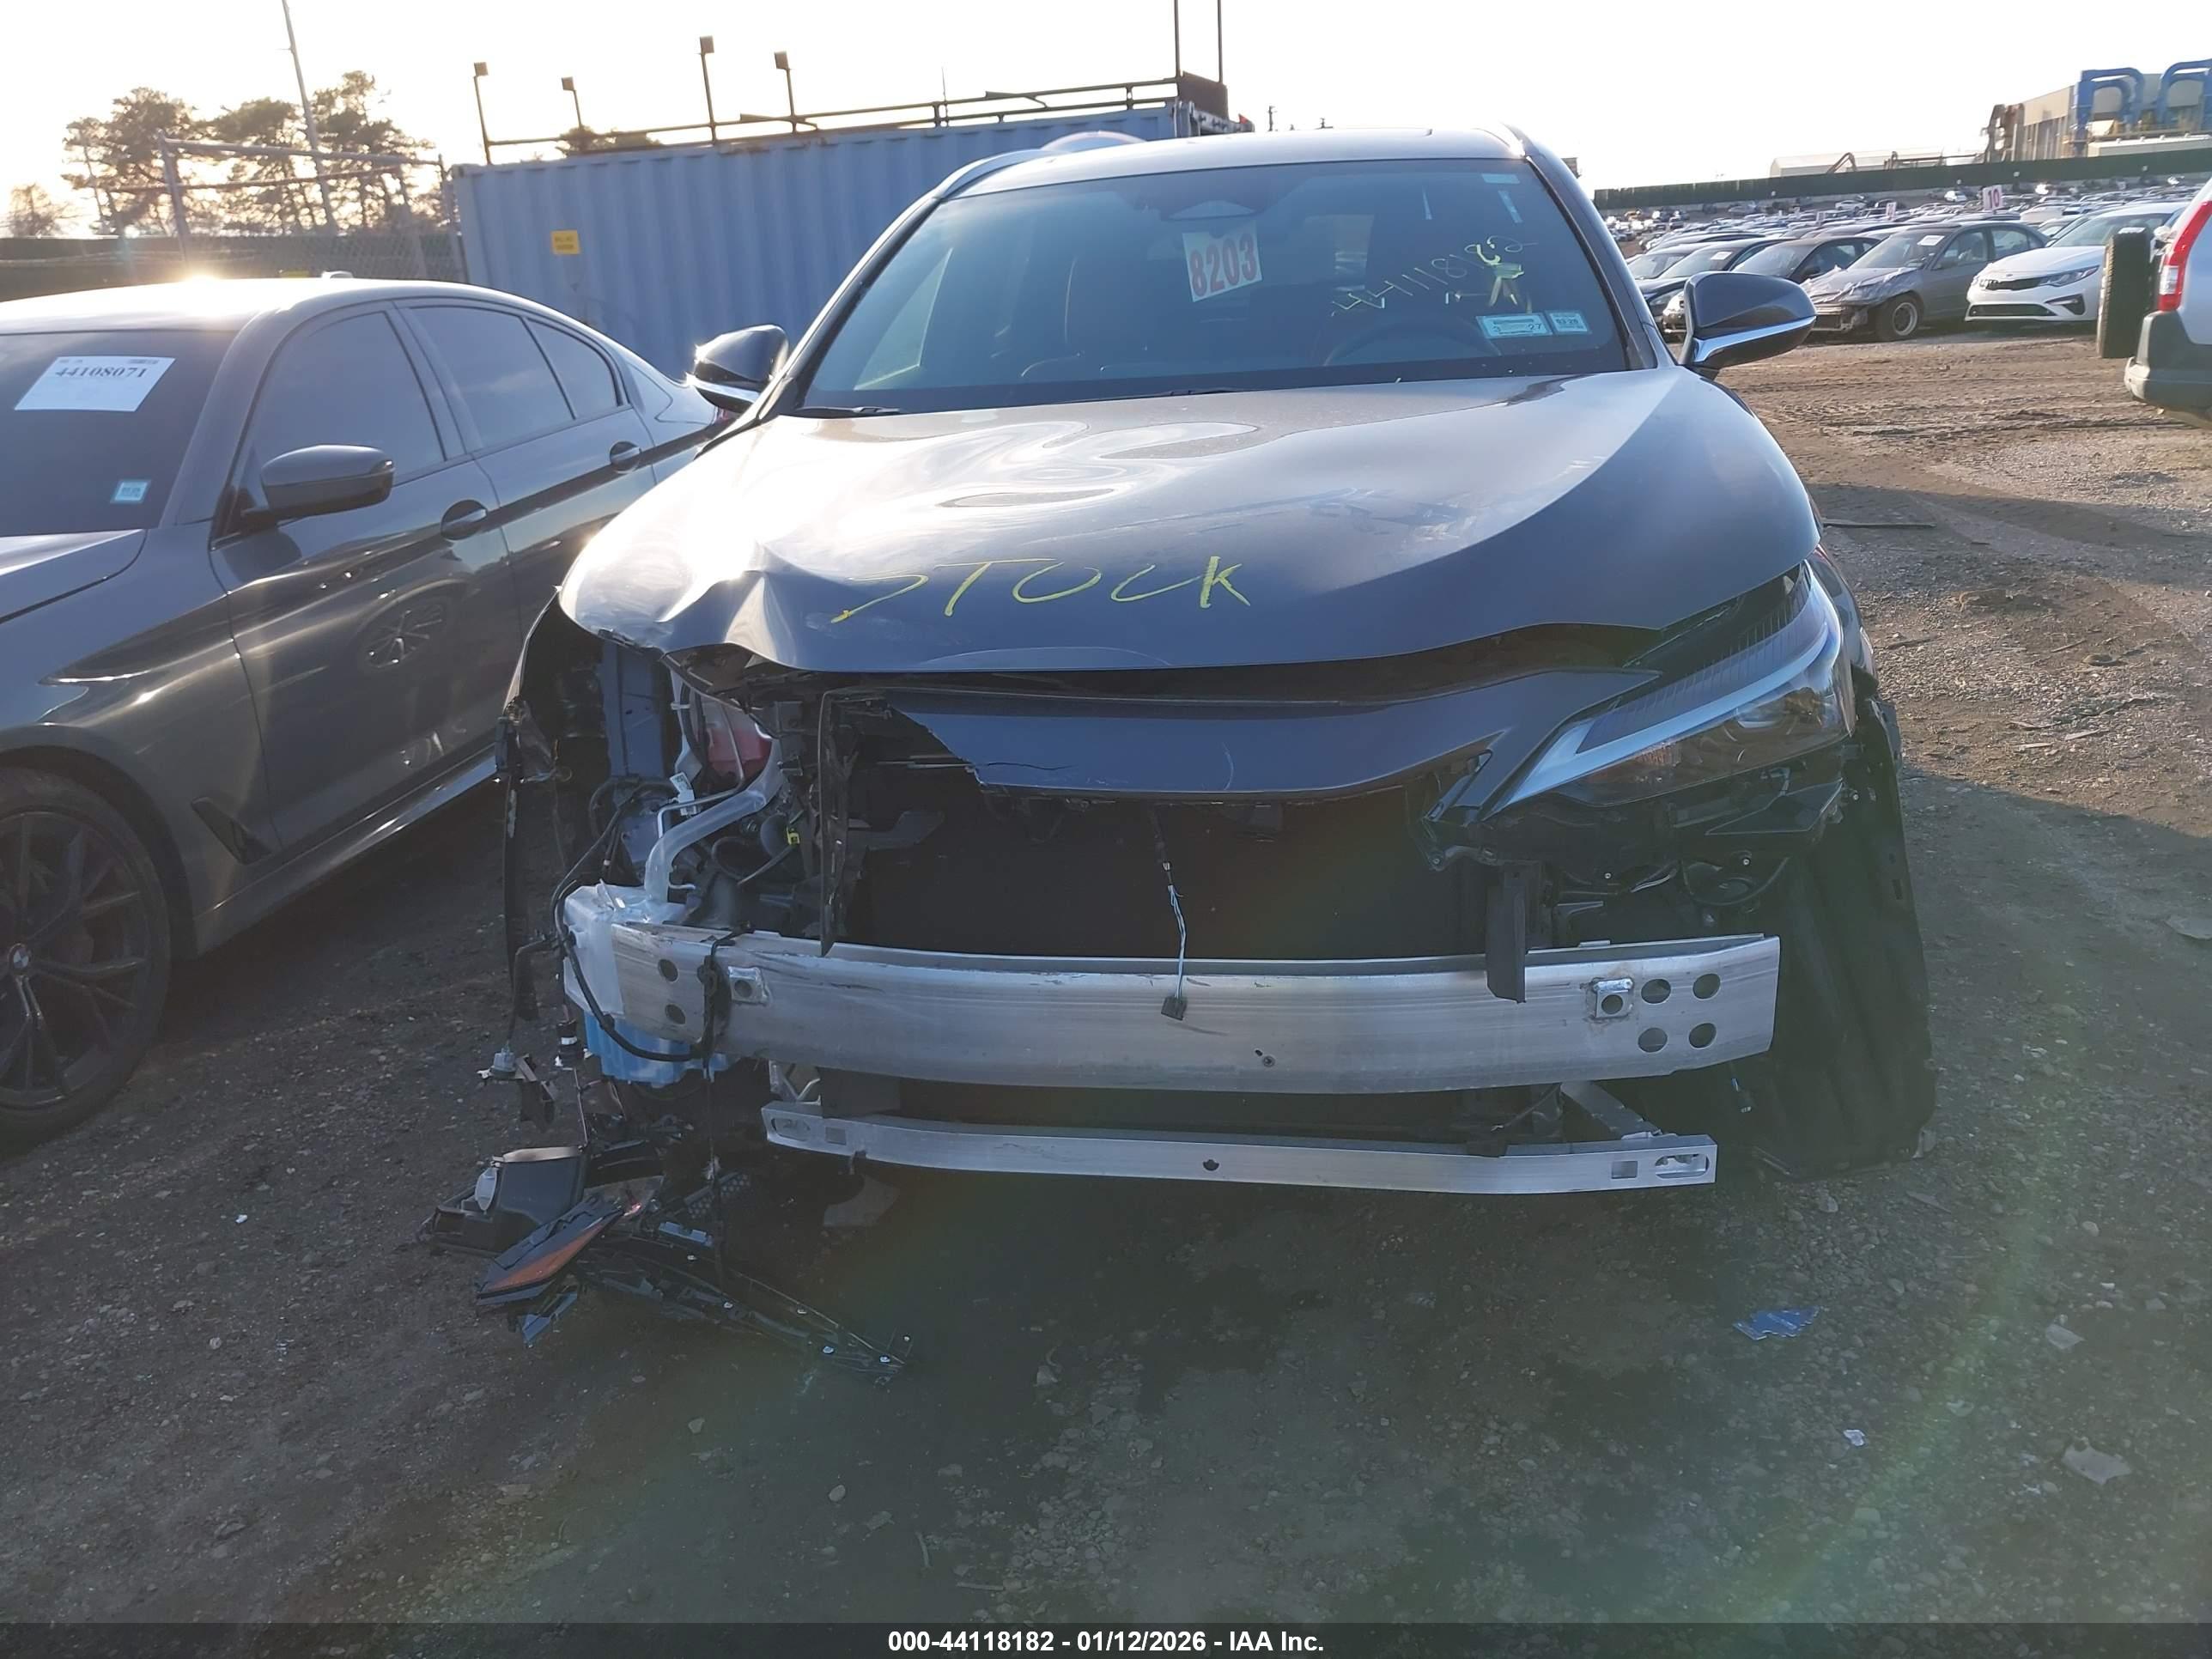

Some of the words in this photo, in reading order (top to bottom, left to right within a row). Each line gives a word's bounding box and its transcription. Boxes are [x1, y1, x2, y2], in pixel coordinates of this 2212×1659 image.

[1986, 188, 2001, 210] 10
[1189, 232, 1258, 297] 8203
[1528, 323, 1542, 331] 27
[55, 367, 148, 378] 44108071
